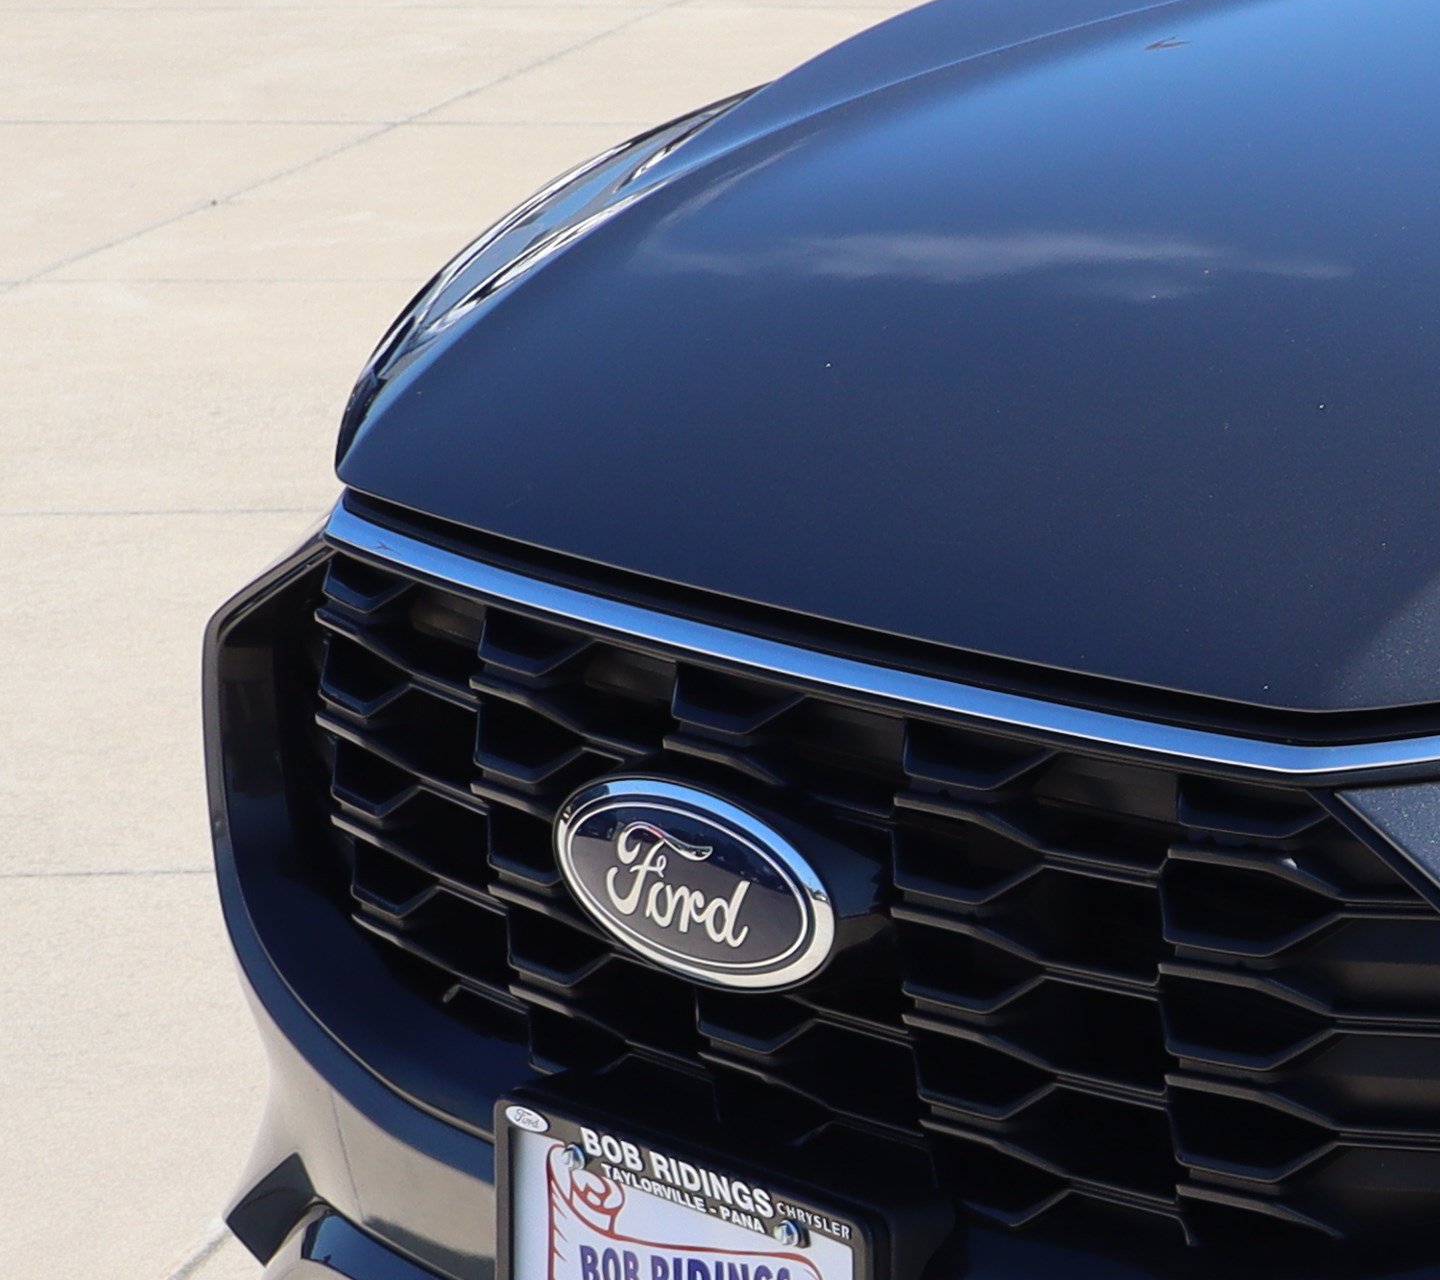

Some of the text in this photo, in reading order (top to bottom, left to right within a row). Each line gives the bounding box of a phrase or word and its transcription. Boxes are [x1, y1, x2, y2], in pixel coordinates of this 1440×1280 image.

[606, 821, 750, 948] Ford
[580, 1126, 776, 1219] BOB RIDINGS
[601, 1162, 707, 1214] TAYLORVILLE
[721, 1205, 767, 1234] PANA
[776, 1201, 851, 1241] CHRYSLER
